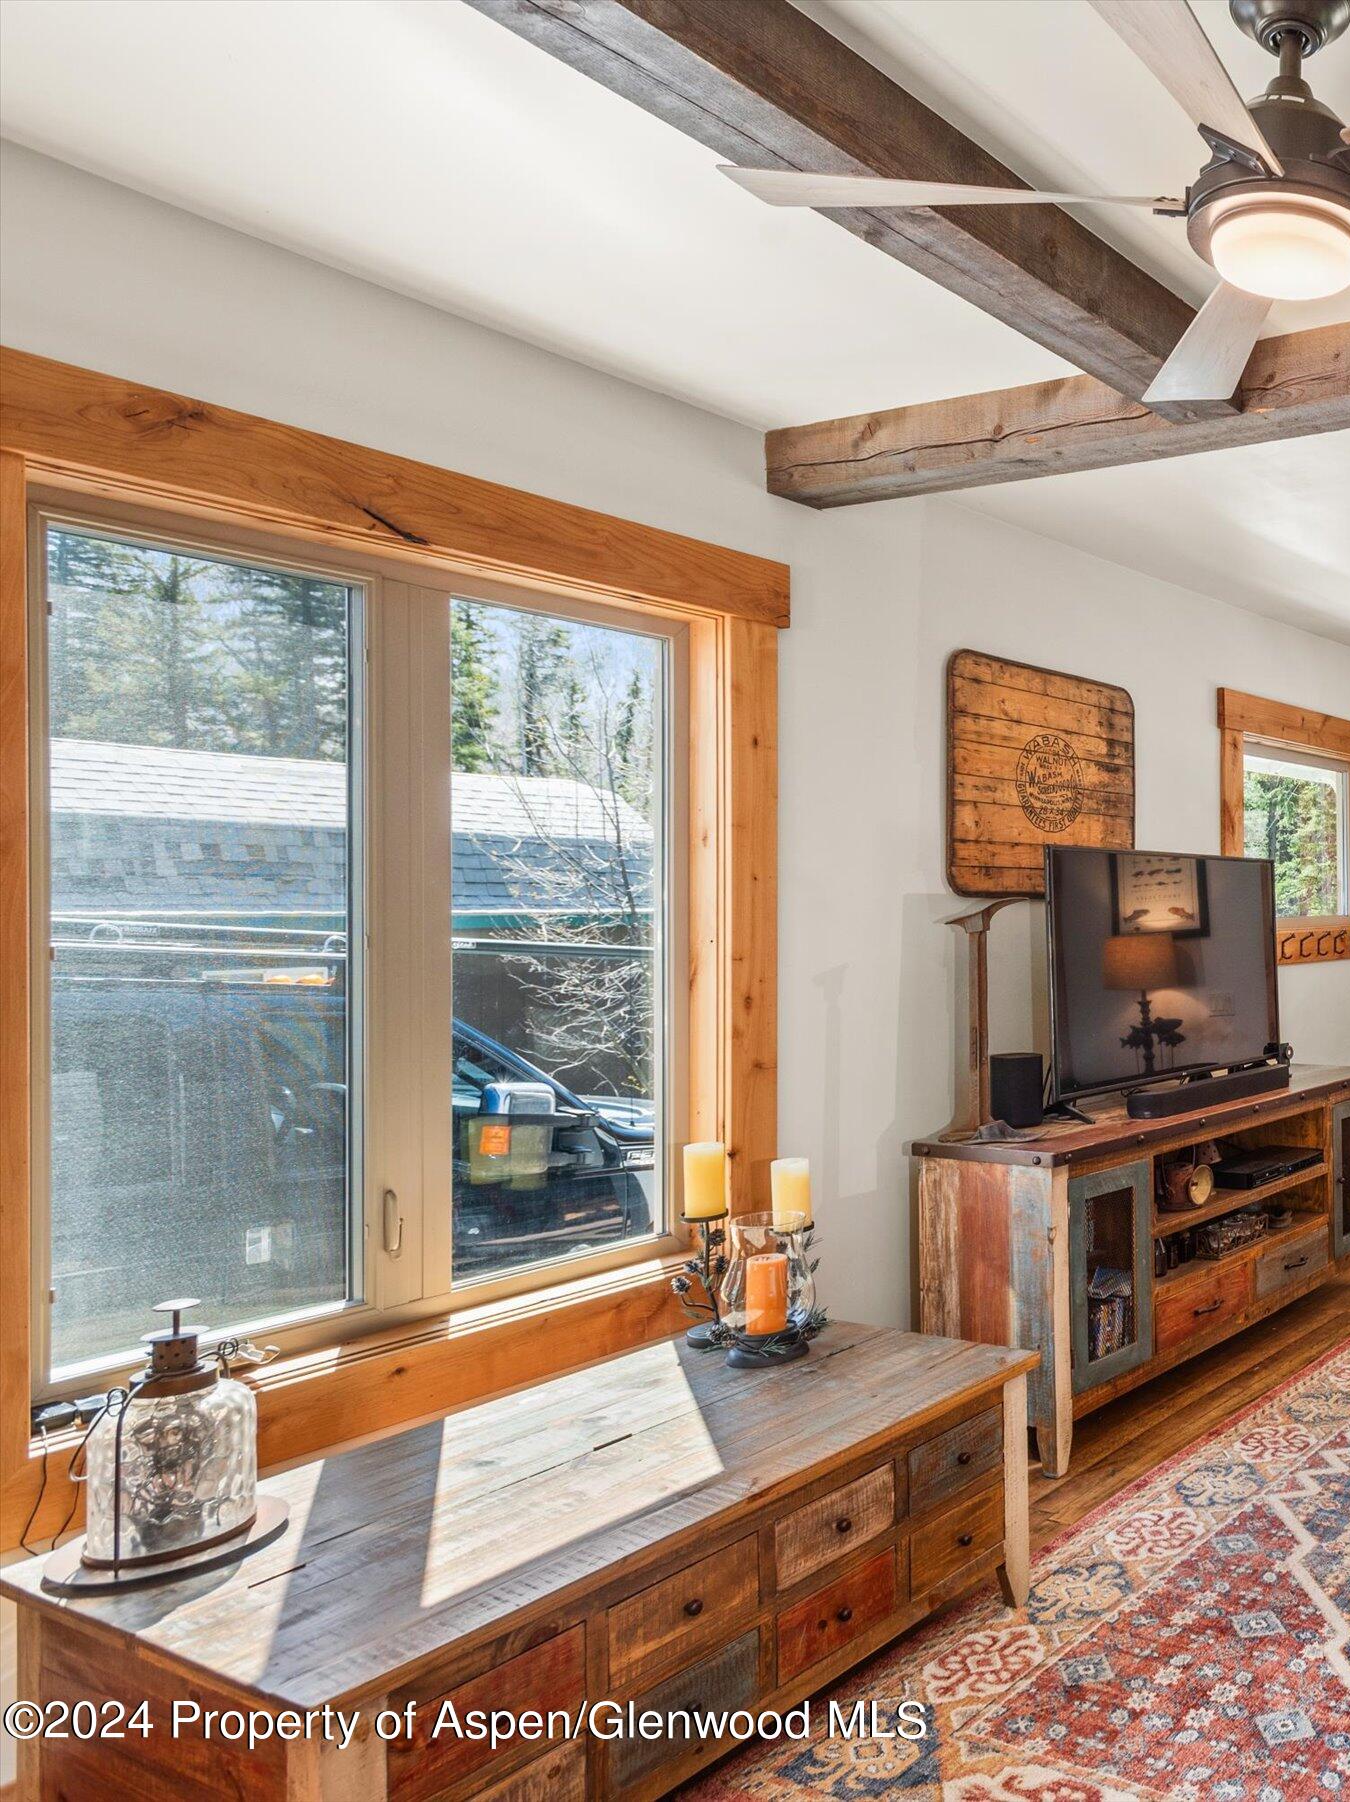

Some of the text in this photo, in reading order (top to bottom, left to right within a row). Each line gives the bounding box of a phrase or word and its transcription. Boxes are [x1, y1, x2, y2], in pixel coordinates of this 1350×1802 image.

[1023, 736, 1078, 767] WABASH
[1036, 755, 1067, 767] WALNUT
[1027, 767, 1062, 788] WABASH
[1048, 818, 1067, 831] FIRST
